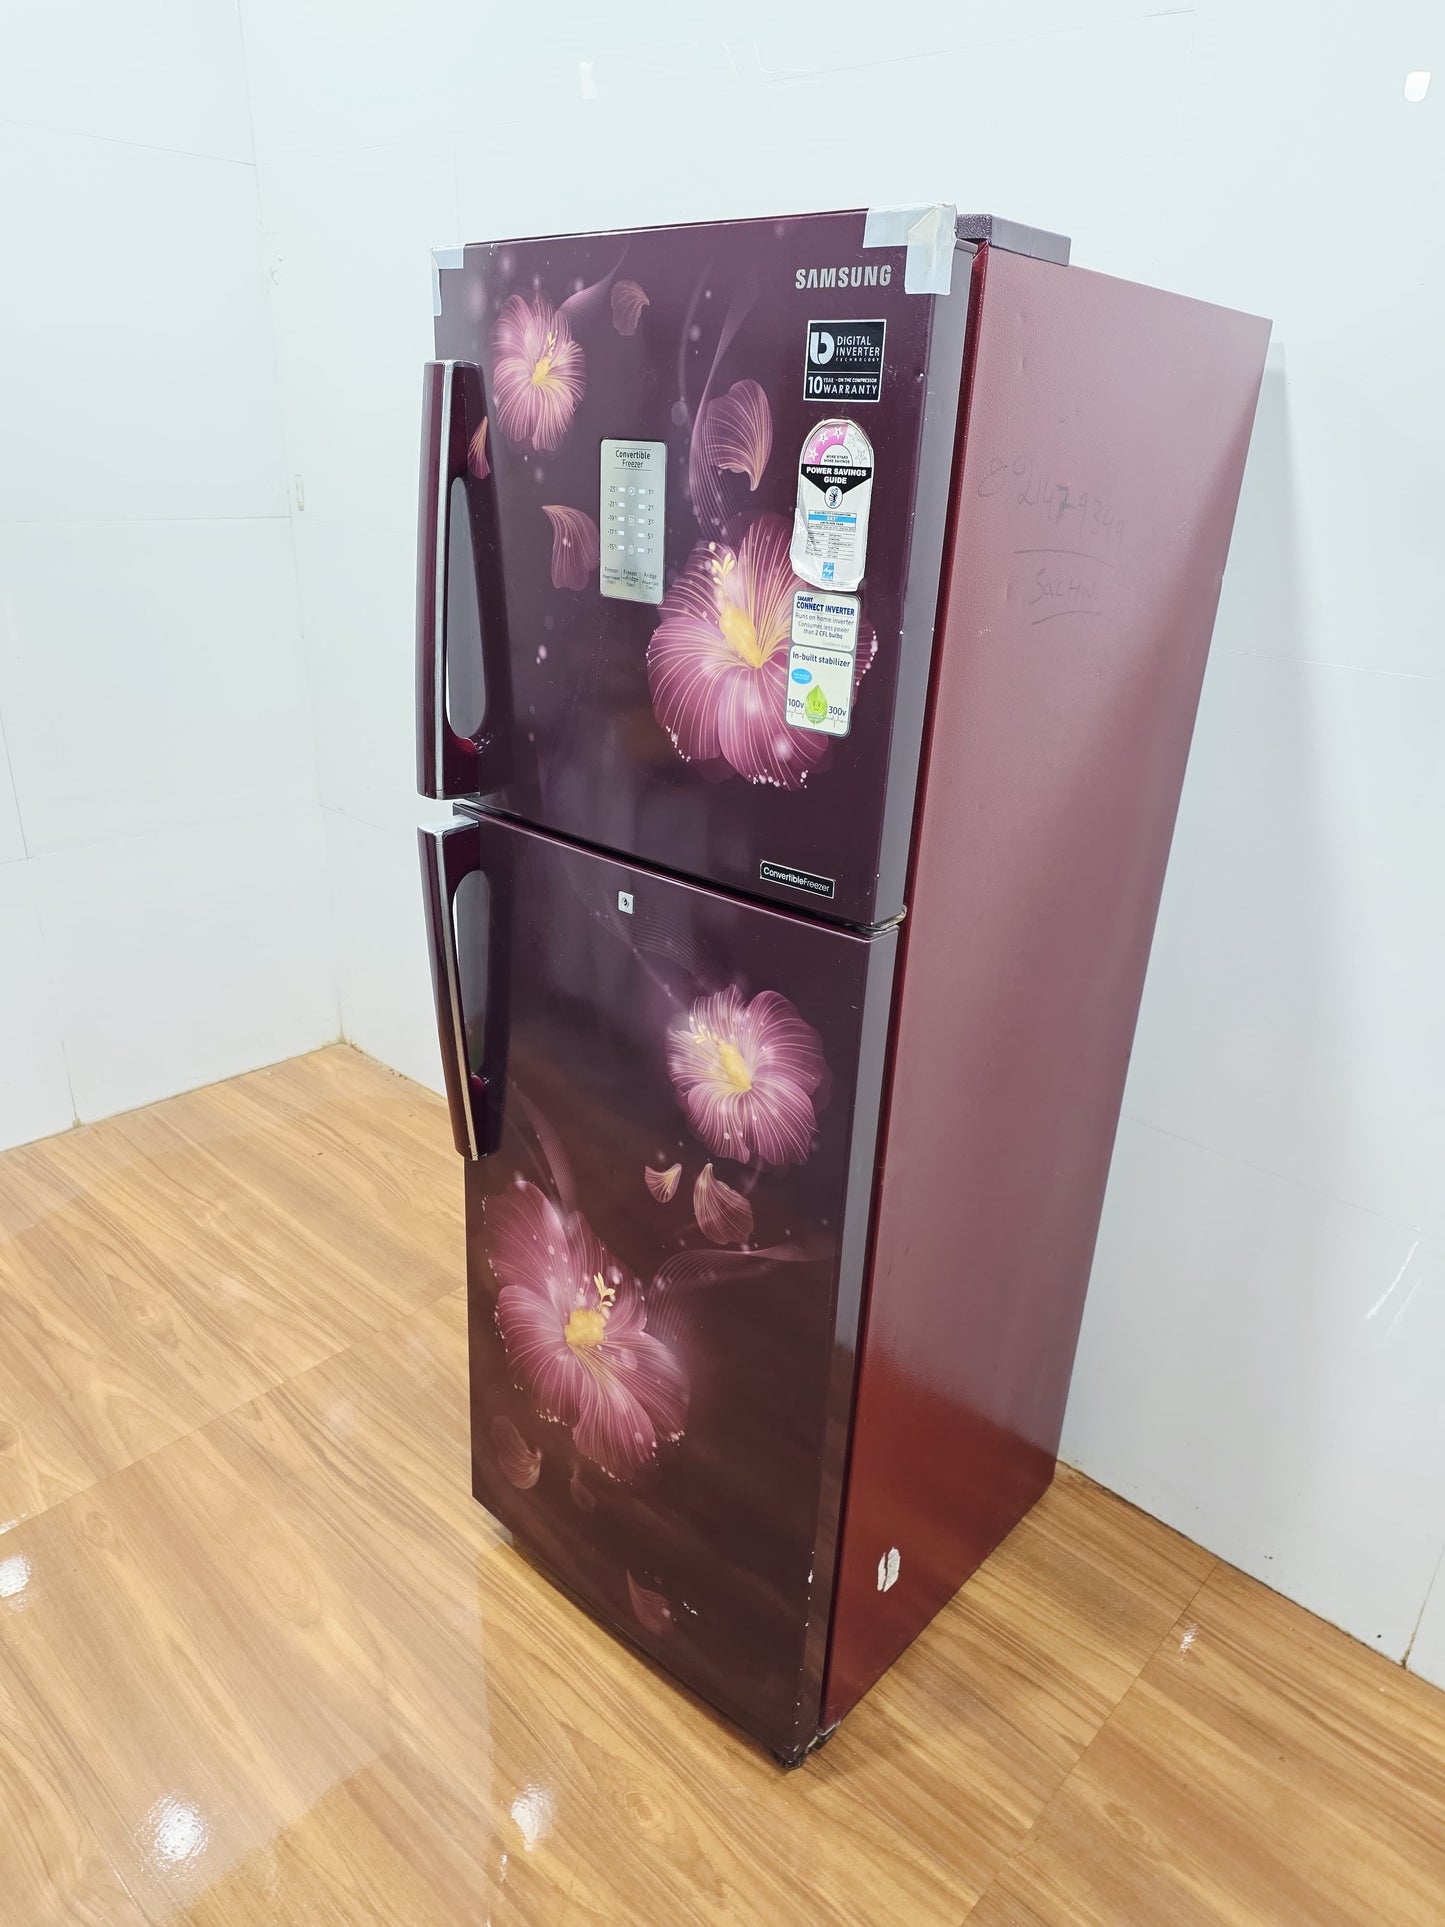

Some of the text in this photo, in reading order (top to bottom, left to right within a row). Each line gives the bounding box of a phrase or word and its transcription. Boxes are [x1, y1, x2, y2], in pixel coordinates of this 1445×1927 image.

[795, 265, 892, 289] SAMSUNG
[836, 336, 871, 346] DIGITAL
[836, 346, 880, 357] INVERTER
[808, 376, 823, 394] 10
[823, 384, 877, 395] WARRANTY
[615, 449, 651, 460] Convertible
[622, 459, 643, 468] Freezer
[806, 466, 867, 477] POWER SAVINGS
[823, 476, 848, 485] GUIDE
[797, 595, 813, 603] SMART
[796, 601, 855, 616] CONNECT INVERTER
[795, 612, 808, 620] Runs
[816, 615, 832, 623] home
[798, 621, 823, 629] Consumes
[828, 631, 843, 639] bulbs
[792, 651, 850, 668] In-built stabilizer
